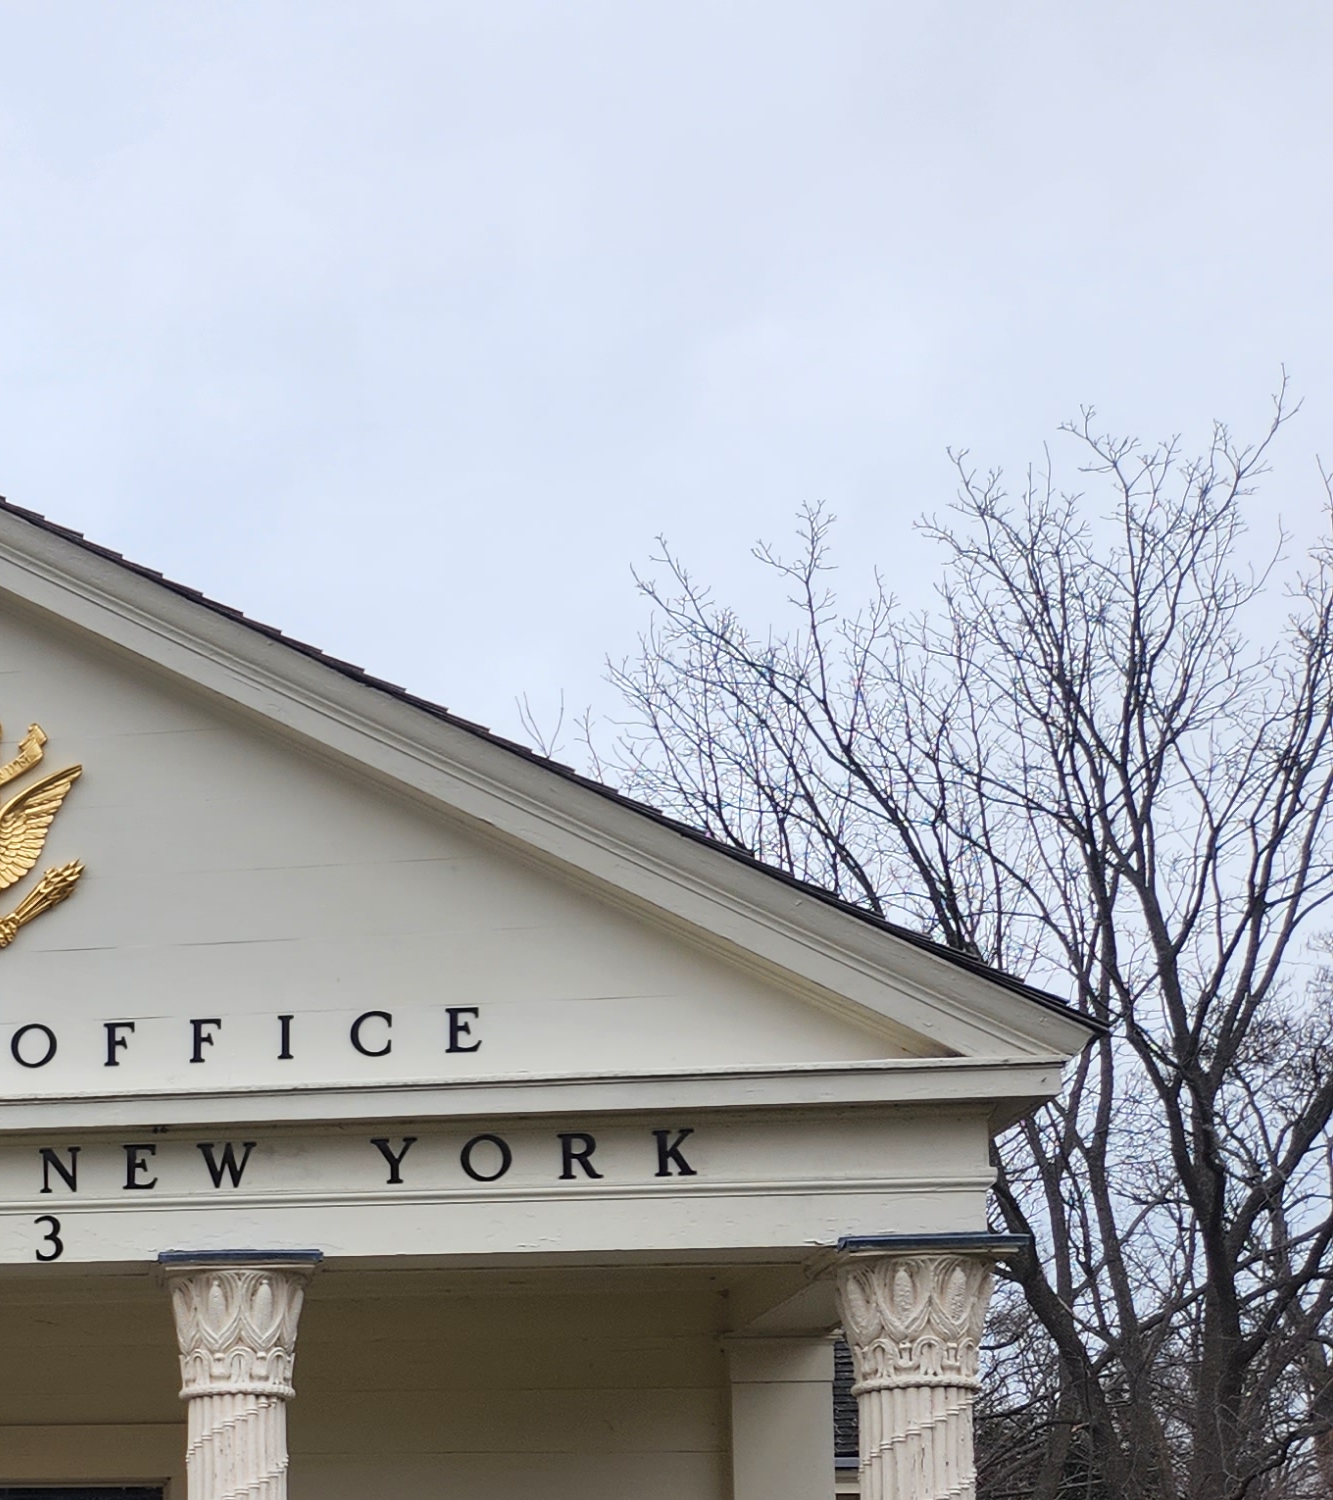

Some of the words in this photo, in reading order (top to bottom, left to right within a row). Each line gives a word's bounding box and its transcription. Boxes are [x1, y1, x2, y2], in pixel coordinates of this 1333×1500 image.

[9, 1005, 483, 1070] OFFICE
[38, 1141, 257, 1194] NEW
[369, 1127, 698, 1184] YORK
